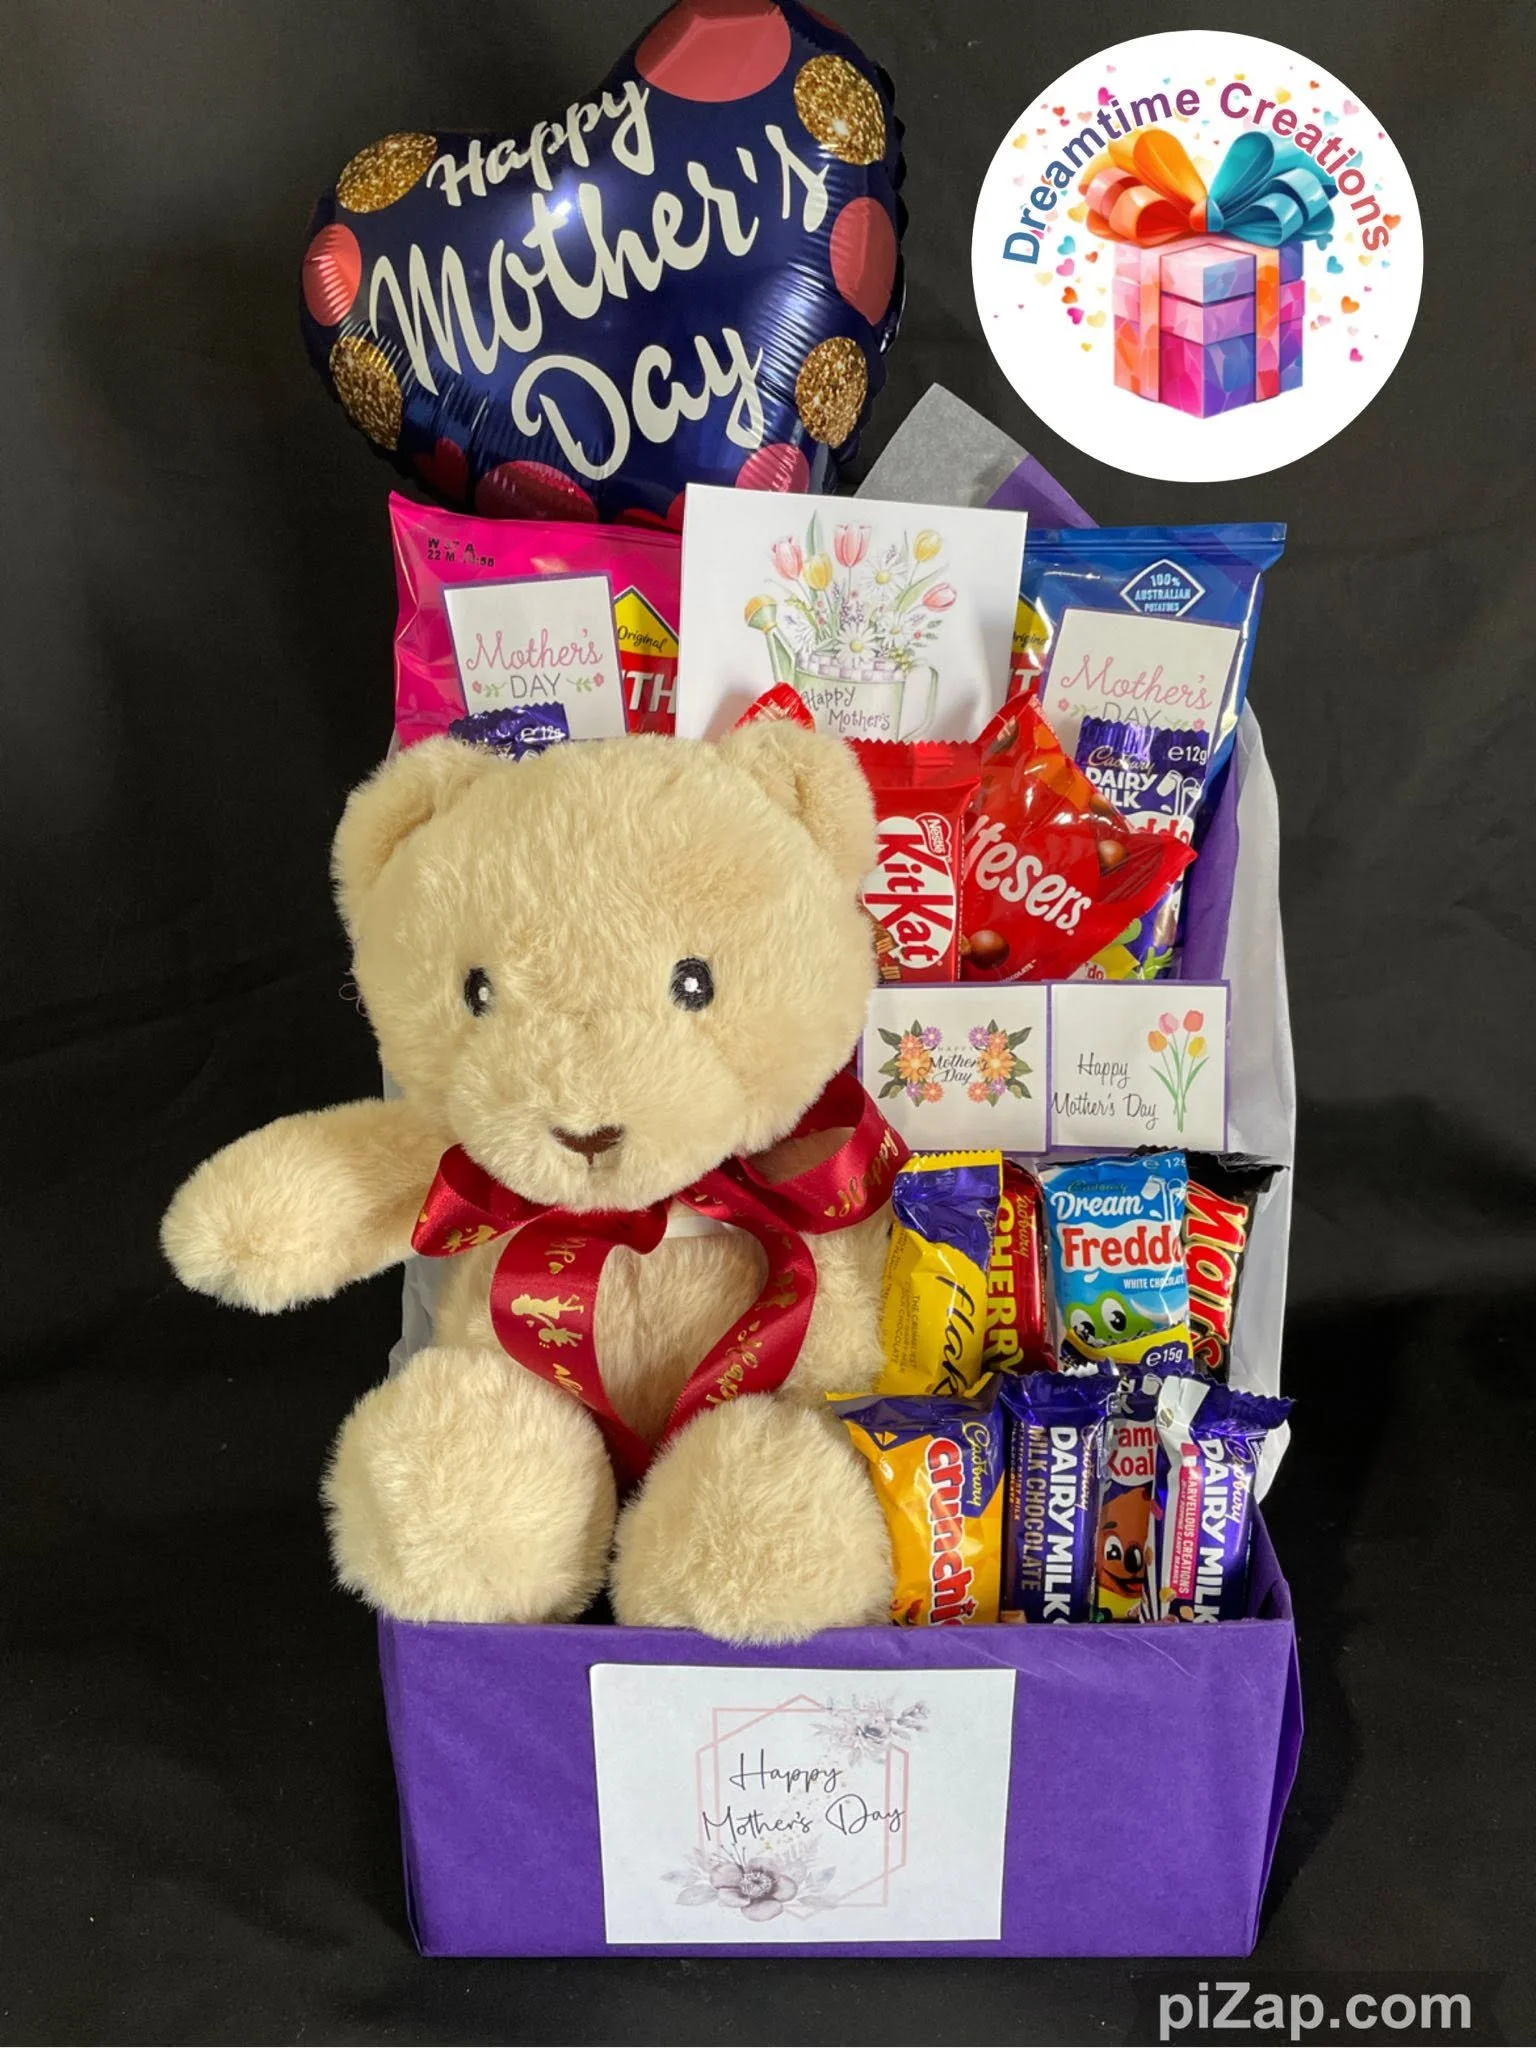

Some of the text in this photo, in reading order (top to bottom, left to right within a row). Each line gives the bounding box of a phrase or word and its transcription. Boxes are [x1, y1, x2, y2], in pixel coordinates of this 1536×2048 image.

[426, 80, 654, 206] Happy
[369, 124, 829, 396] Mother's
[511, 327, 764, 480] Day
[1135, 588, 1191, 601] AUSTRALIAN
[1150, 573, 1181, 587] 100%
[466, 628, 603, 671] Mother's
[617, 625, 667, 653] Original
[510, 672, 561, 699] DAY
[621, 669, 679, 715] TH
[801, 686, 856, 711] Happy
[1060, 654, 1212, 710] Mother's
[828, 707, 890, 733] Mother's
[1102, 701, 1162, 724] DAY
[1085, 766, 1158, 791] DAIRY
[1076, 1052, 1128, 1088] Happy
[1050, 1092, 1159, 1129] Mother's Day
[1050, 1191, 1145, 1221] Dream
[1123, 1277, 1148, 1289] WHITE
[932, 1276, 975, 1398] flak
[962, 1421, 991, 1508] Cadbury
[1021, 1424, 1048, 1592] MILK CHOCOLATE
[1042, 1426, 1078, 1619] DAIRY MILK
[1193, 1438, 1229, 1623] DAIRY MILK
[1179, 1539, 1195, 1594] CREATIONS
[729, 1748, 843, 1793] Happy
[703, 1793, 906, 1843] Mother's Day
